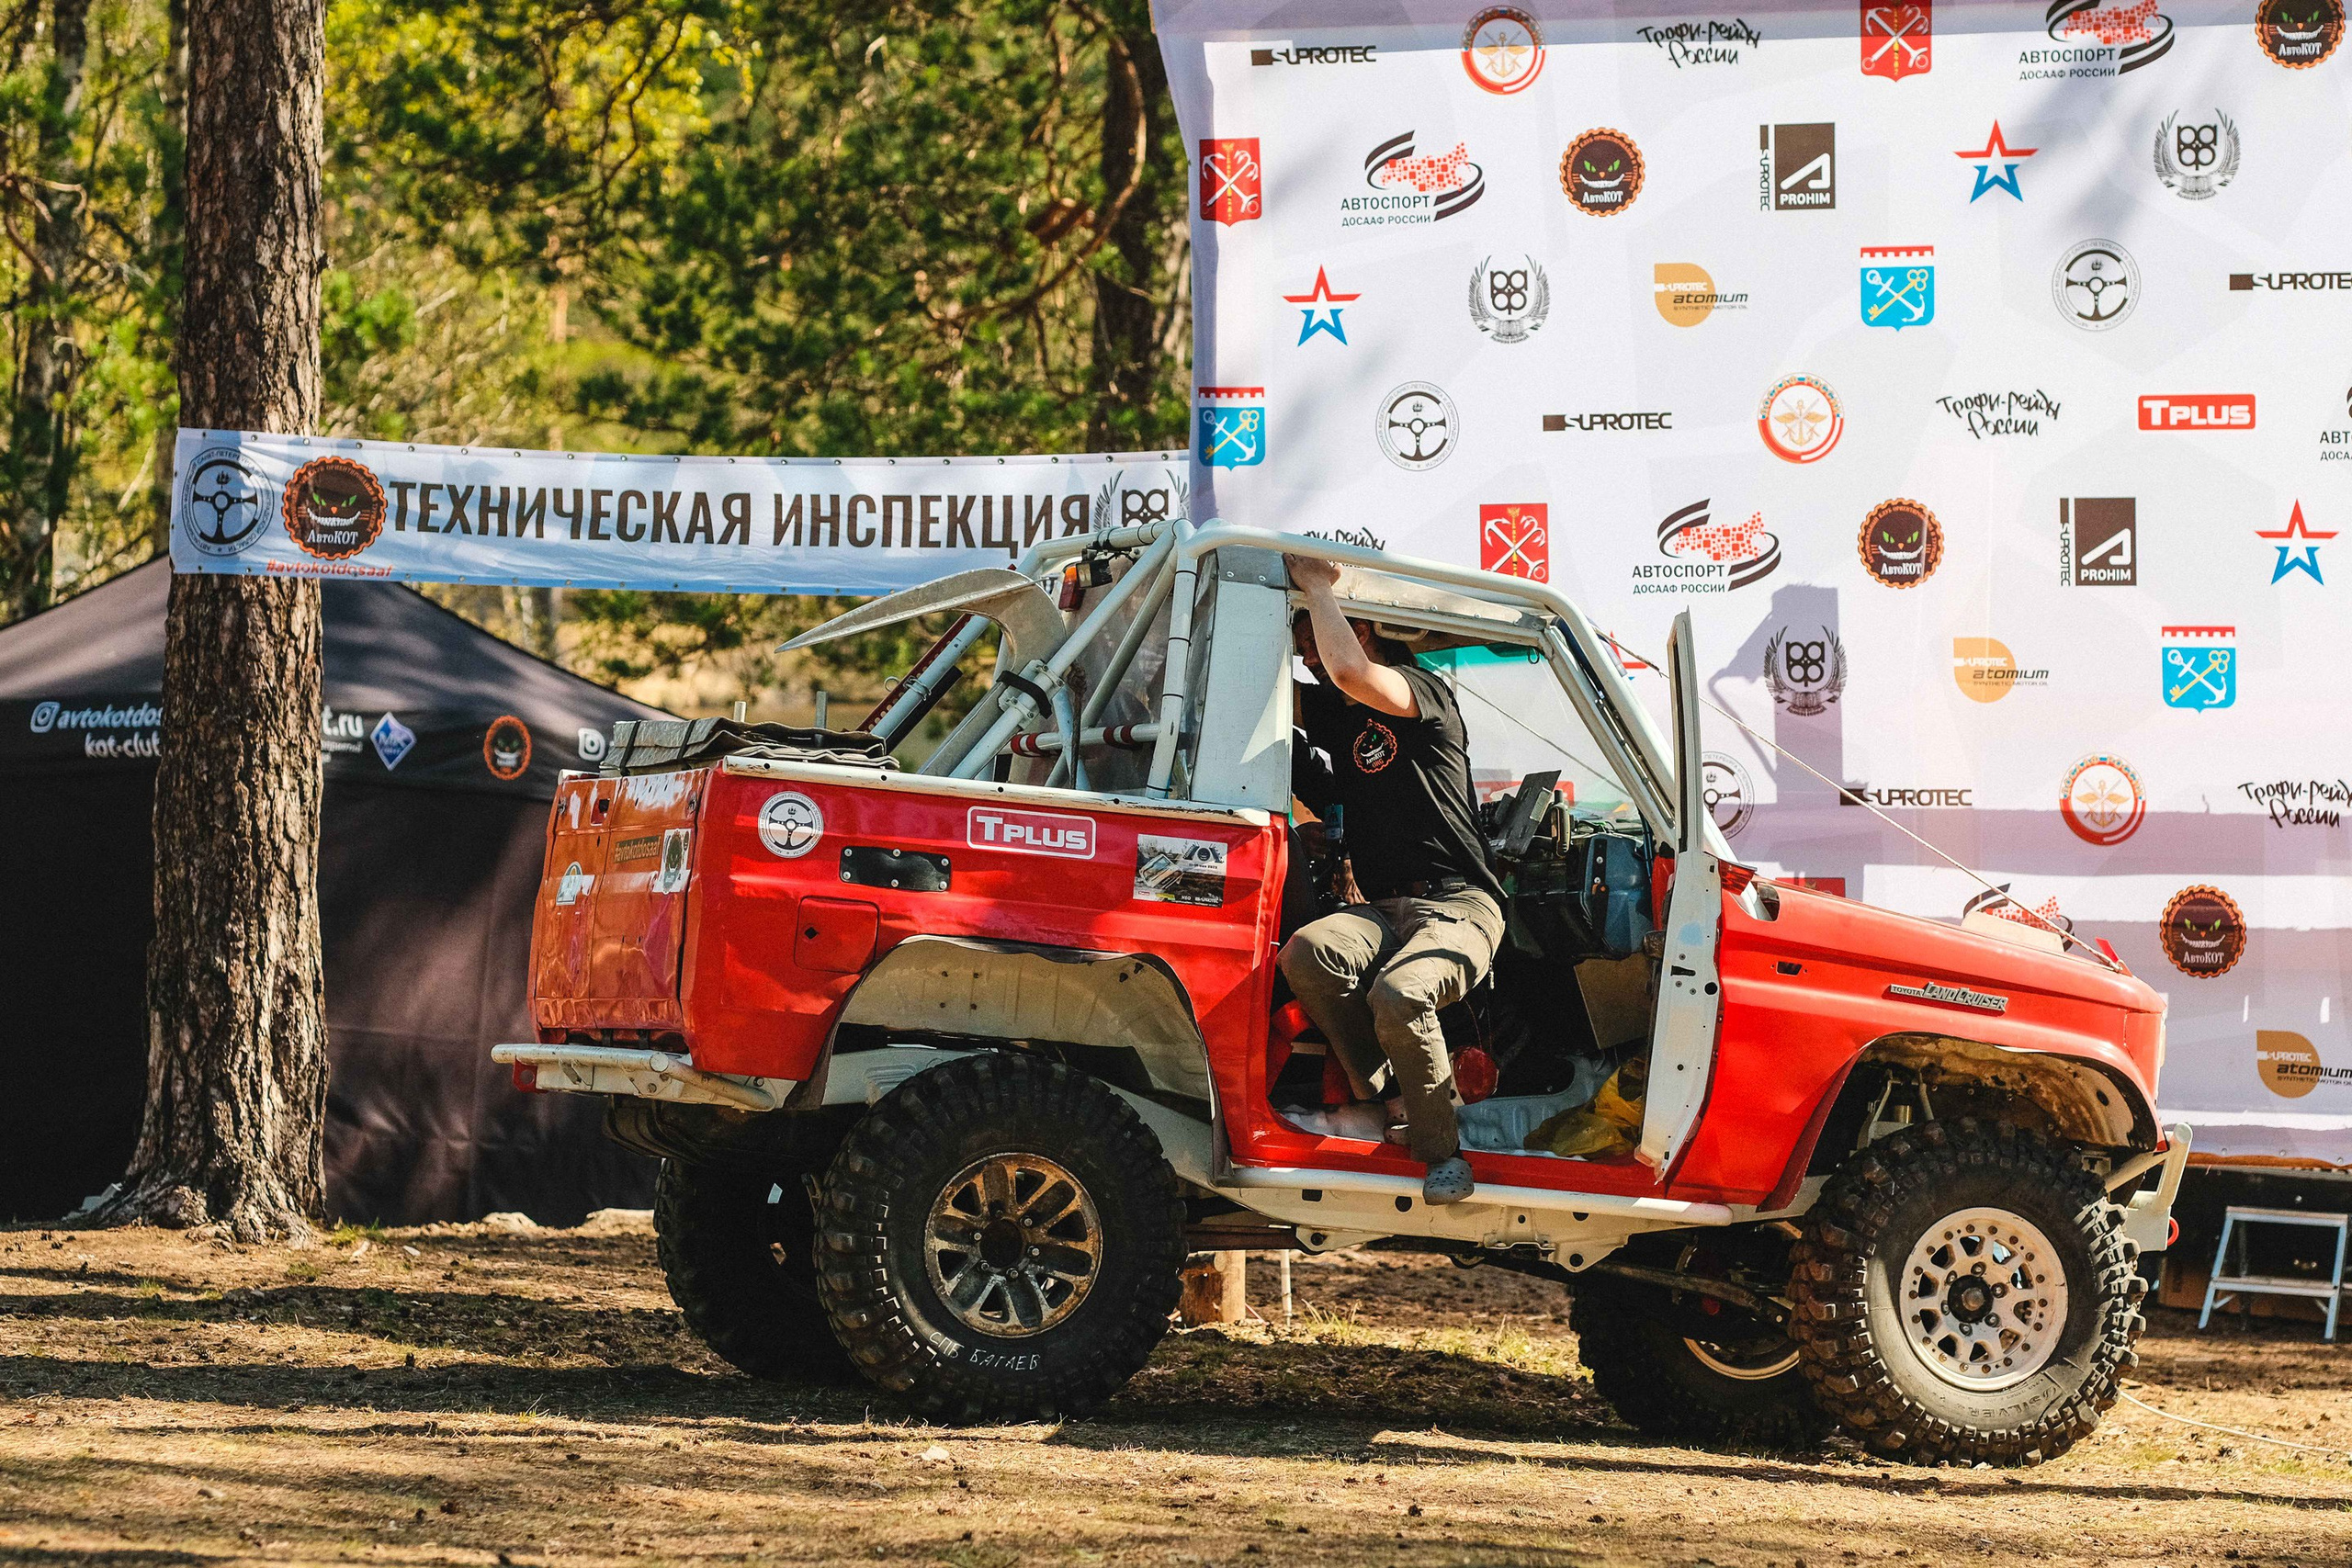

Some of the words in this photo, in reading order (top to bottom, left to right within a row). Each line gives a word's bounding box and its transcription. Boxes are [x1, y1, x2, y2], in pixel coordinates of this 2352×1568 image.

[1272, 46, 1376, 65] SUPROTEC
[2018, 48, 2115, 63] АВТОСПОРТ
[2019, 70, 2065, 81] ДОСААФ
[2069, 68, 2115, 78] РОССИИ
[1340, 195, 1430, 210] АВТОСПОРТ
[1780, 192, 1831, 206] PROHIM
[1341, 216, 1385, 227] ДОСААФ
[1388, 214, 1431, 225] РОССИИ
[2251, 272, 2352, 290] SUPROTE
[1564, 412, 1672, 431] SUPROTEC
[388, 480, 752, 546] ТЕХНИЧЕСКАЯ
[772, 492, 1091, 559] ИНСПЕКЦИЯ
[1632, 564, 1725, 578] АВТОСПОРТ
[2080, 568, 2132, 581] PROHIM
[1633, 584, 1678, 594] ДОСААФ
[1681, 583, 1725, 593] РОССИИ
[1862, 788, 1973, 807] SUPROTEC
[2237, 779, 2352, 808] Трофи-рейд
[1892, 986, 1922, 996] TOYOTA
[929, 1331, 965, 1359] СПБ
